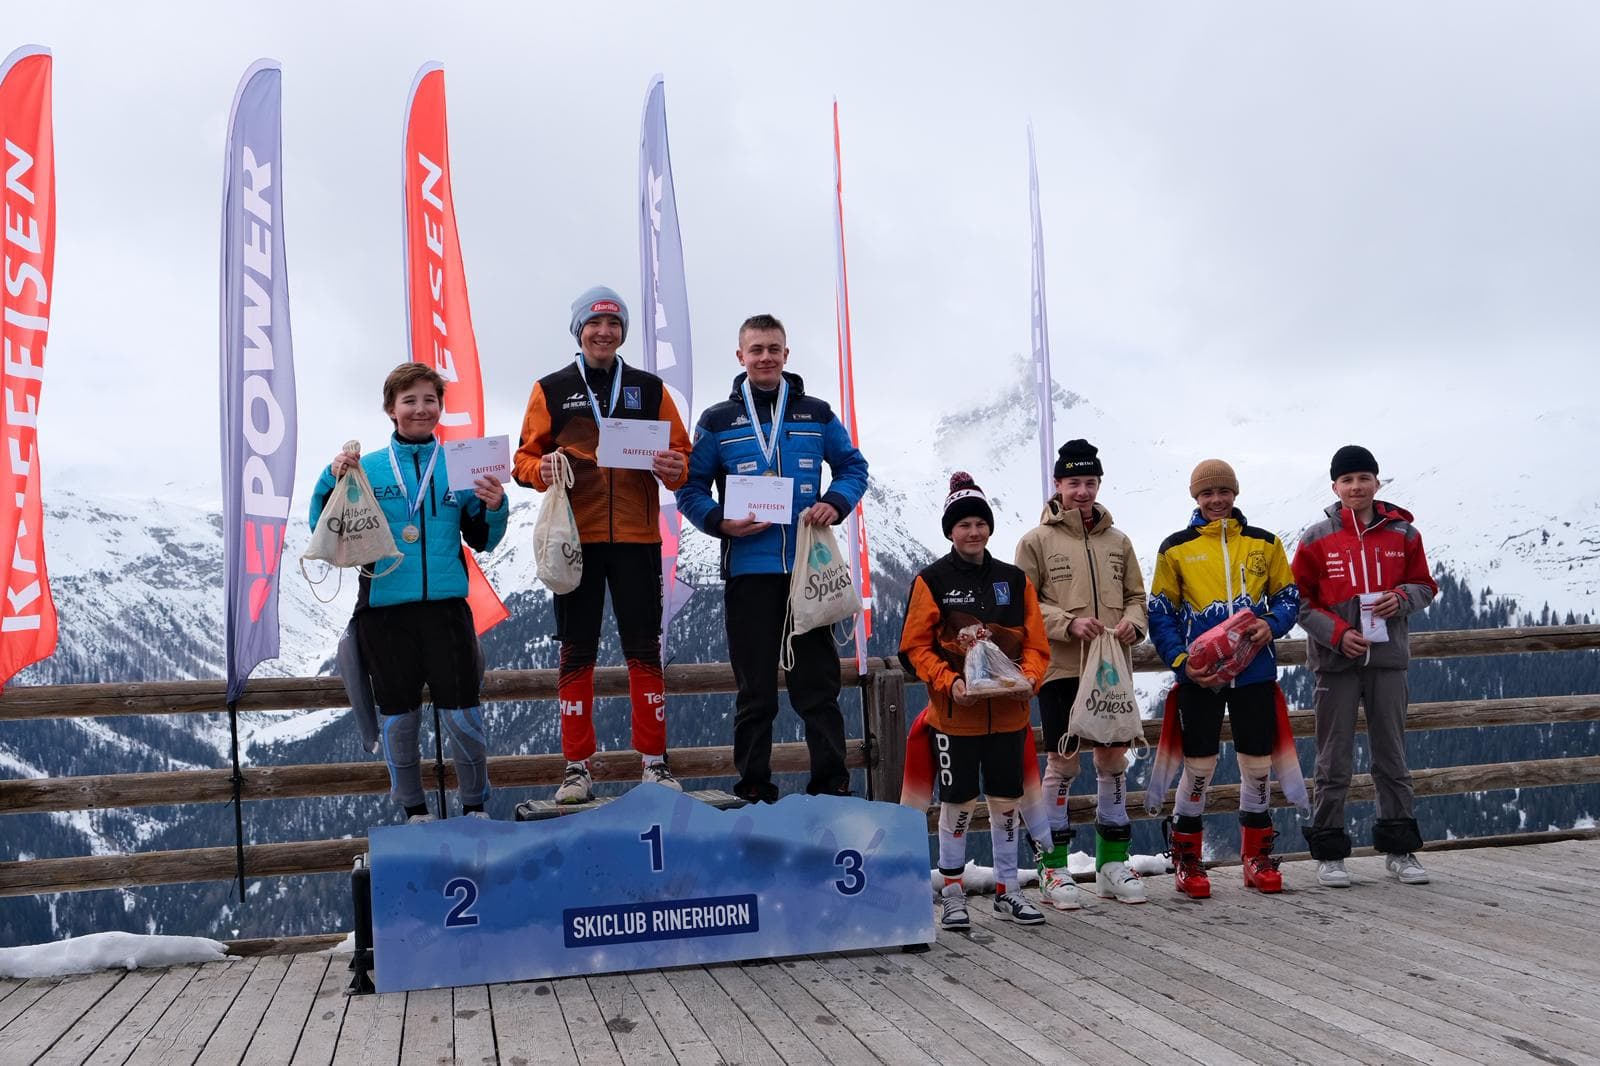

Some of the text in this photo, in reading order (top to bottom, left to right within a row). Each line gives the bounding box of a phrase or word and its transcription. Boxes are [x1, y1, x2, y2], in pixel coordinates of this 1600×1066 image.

[1, 138, 48, 632] RAFFEISEN
[470, 464, 506, 475] RAIFFEISEN
[748, 502, 785, 510] RAIFFEISEN
[640, 823, 664, 873] 1
[833, 849, 866, 897] 3
[444, 877, 480, 929] 2
[572, 903, 750, 939] SKICLUB RINERHORN
